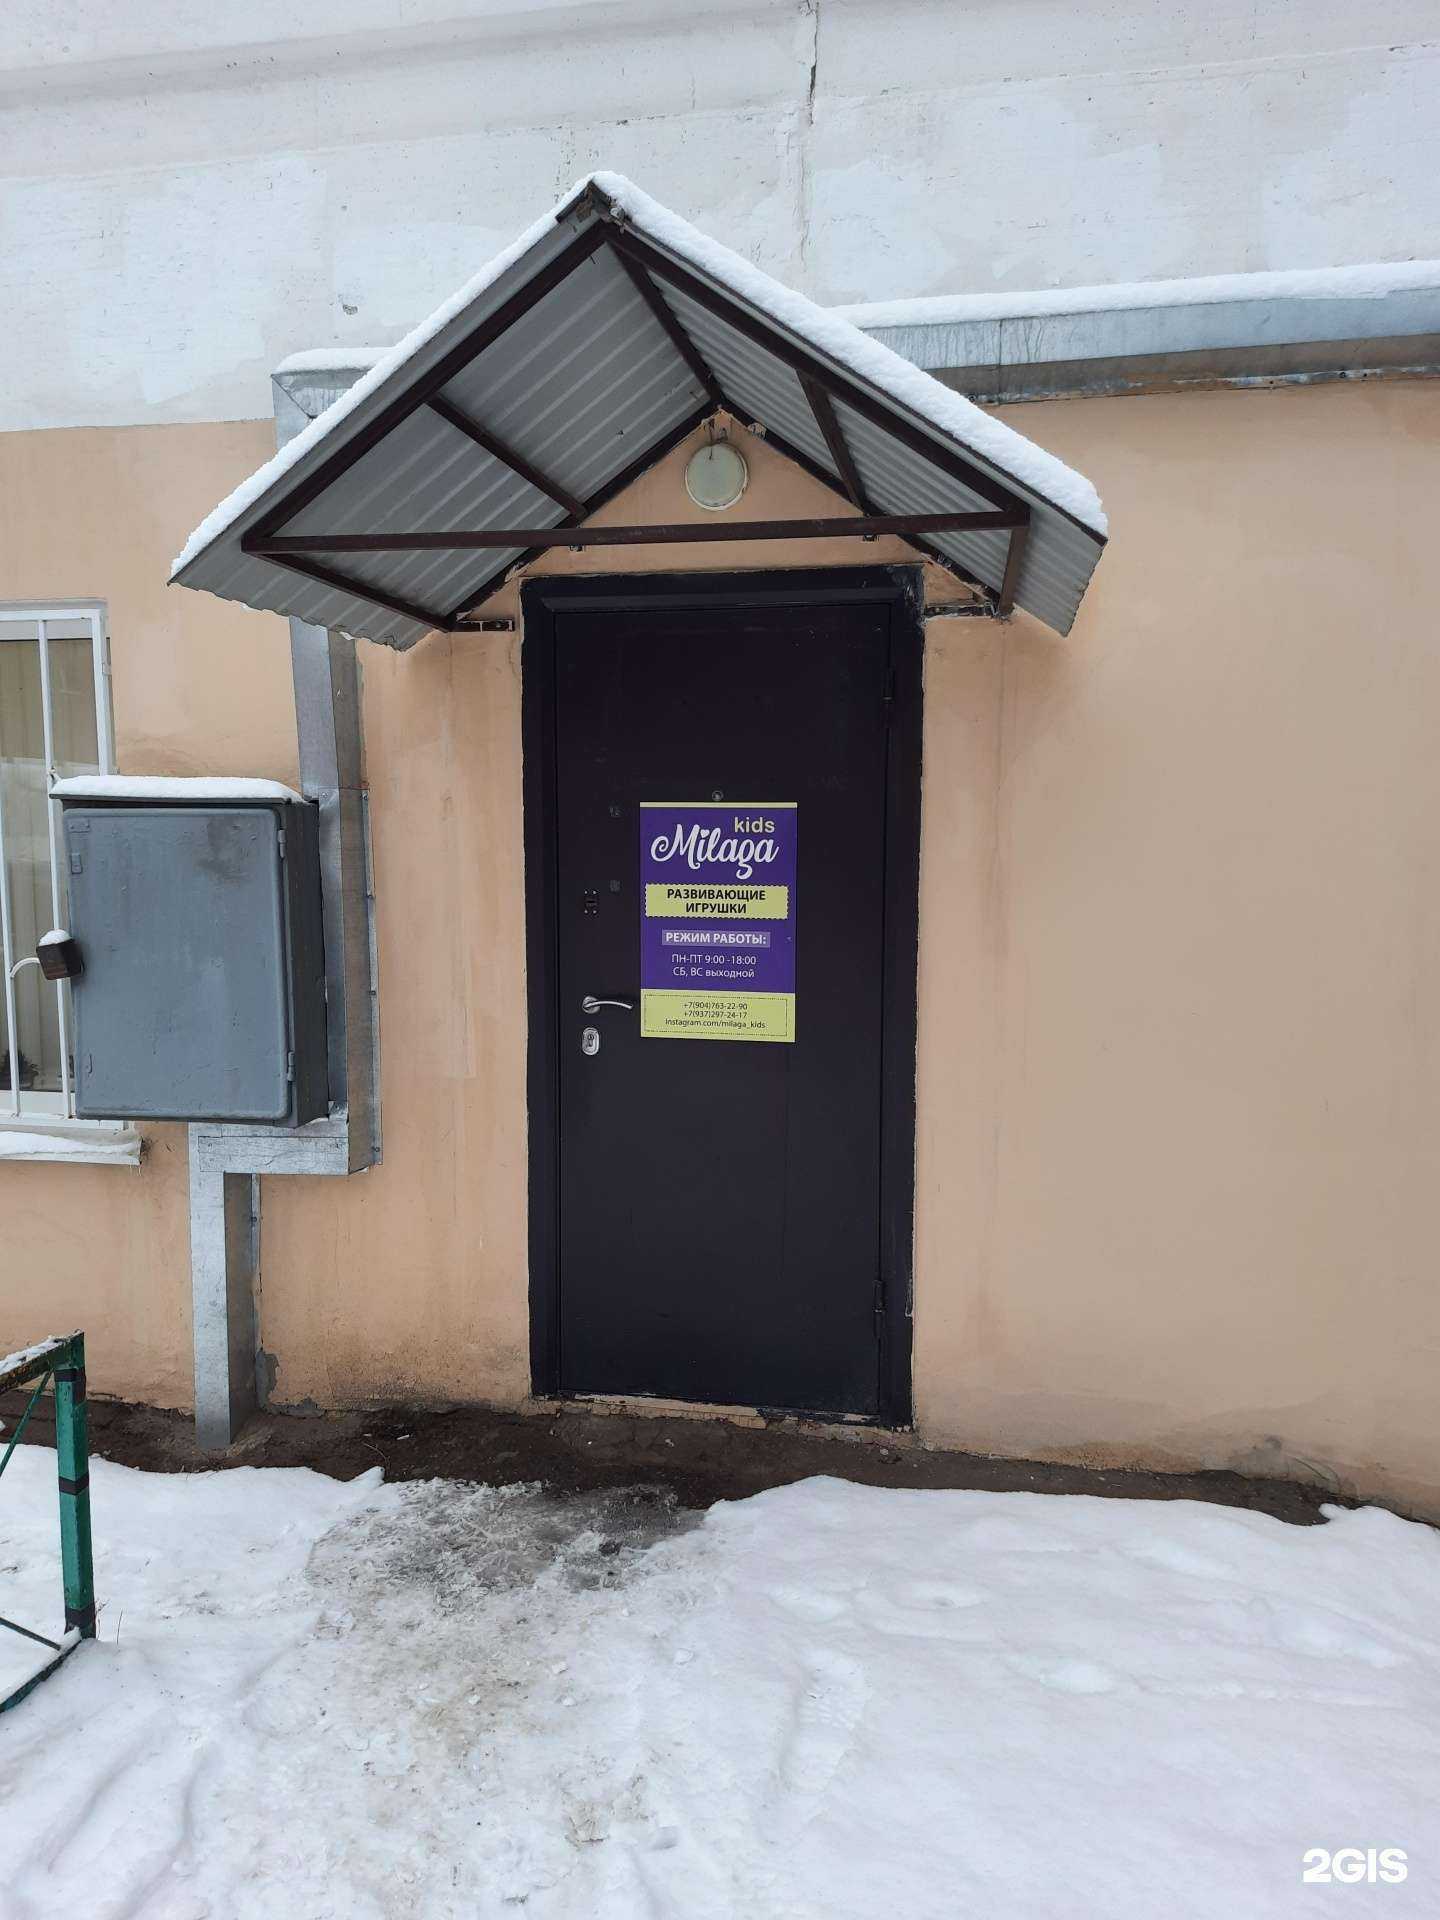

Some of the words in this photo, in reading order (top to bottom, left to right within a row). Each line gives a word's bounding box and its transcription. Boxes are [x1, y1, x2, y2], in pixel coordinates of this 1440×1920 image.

[734, 816, 775, 833] kids
[650, 823, 780, 880] Milaga
[667, 888, 766, 902] РАЗВИВАЮЩИЕ
[685, 902, 747, 914] ИГРУШКИ
[665, 932, 711, 943] РЕЖИМ
[713, 933, 767, 945] РАБОТЫ:
[671, 953, 703, 964] ПН-ПТ
[704, 954, 725, 965] 9:00
[672, 966, 689, 977] СБ,
[690, 967, 703, 977] ВС
[705, 968, 755, 979] выходной
[684, 1001, 748, 1011] +7(904)763-22-90
